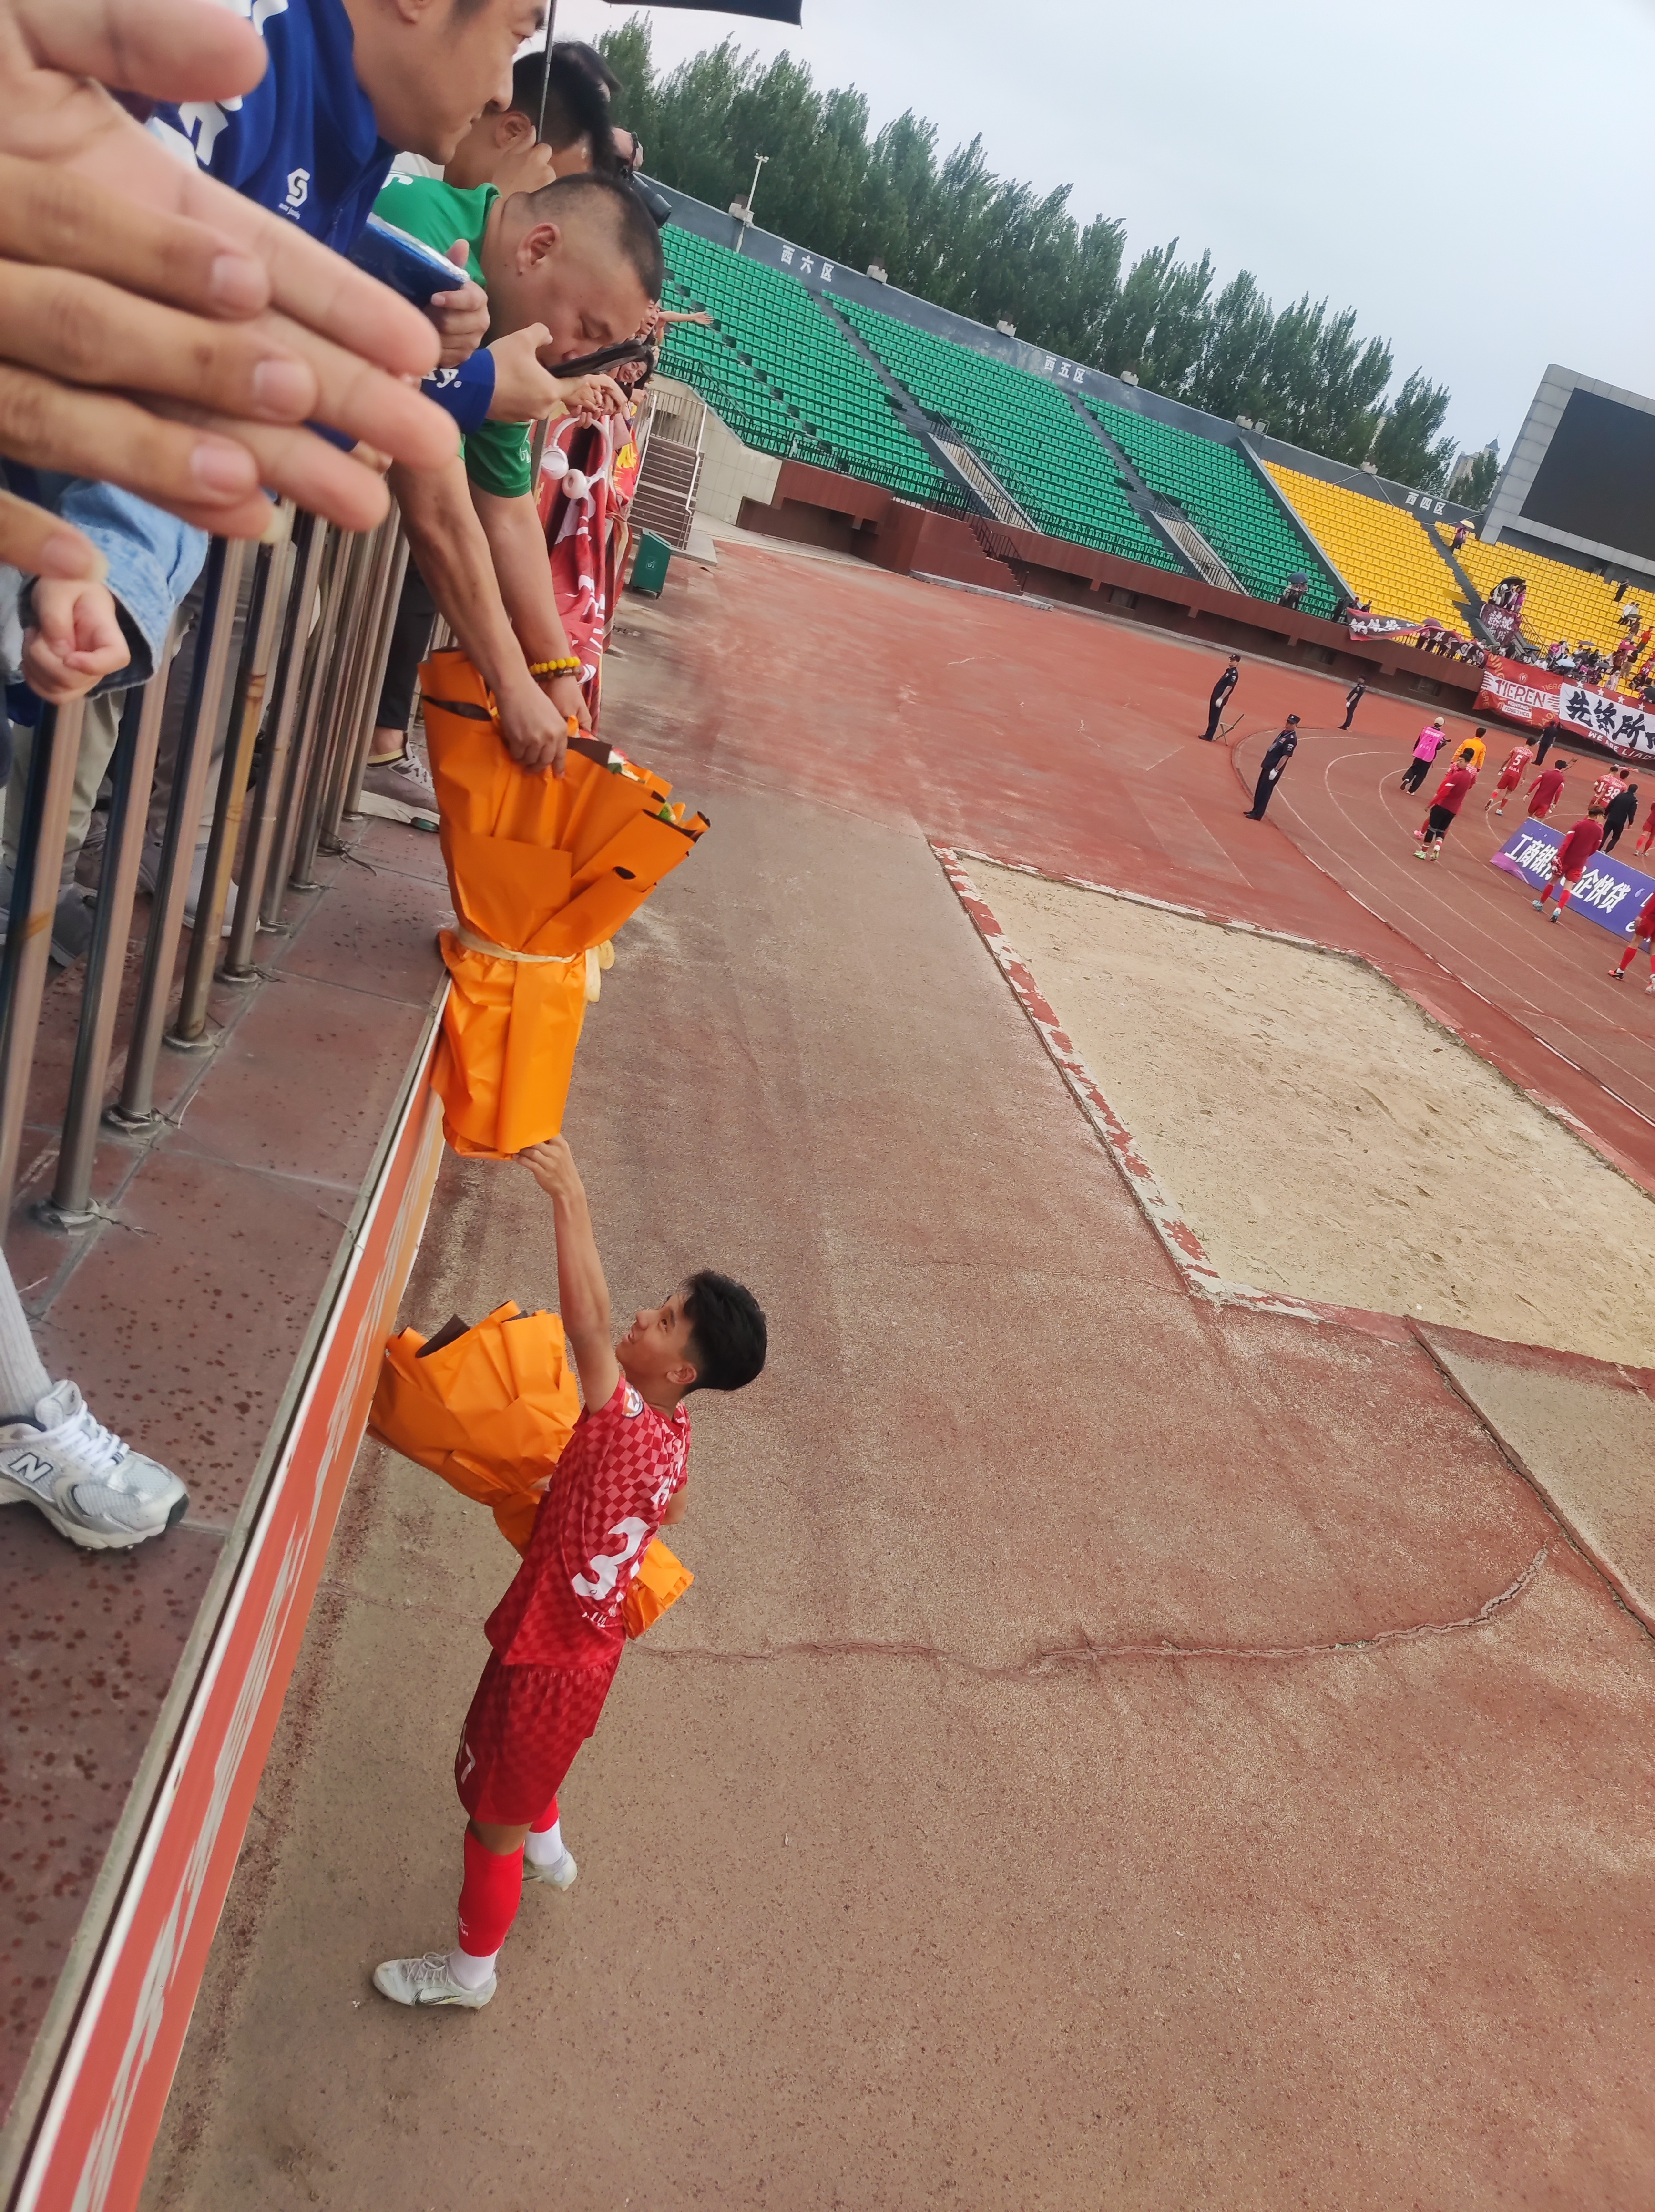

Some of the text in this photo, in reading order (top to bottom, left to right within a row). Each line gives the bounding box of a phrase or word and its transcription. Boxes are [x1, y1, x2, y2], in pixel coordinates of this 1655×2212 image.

[780, 244, 835, 282] 西六区
[1044, 355, 1086, 384] 西五区
[1405, 491, 1446, 515] 西四区
[1504, 706, 1530, 717] TOGETHER
[1588, 731, 1655, 760] WE ARE LIAO
[1512, 754, 1523, 766] 5
[1604, 786, 1620, 799] 38
[8, 1452, 53, 1483] N
